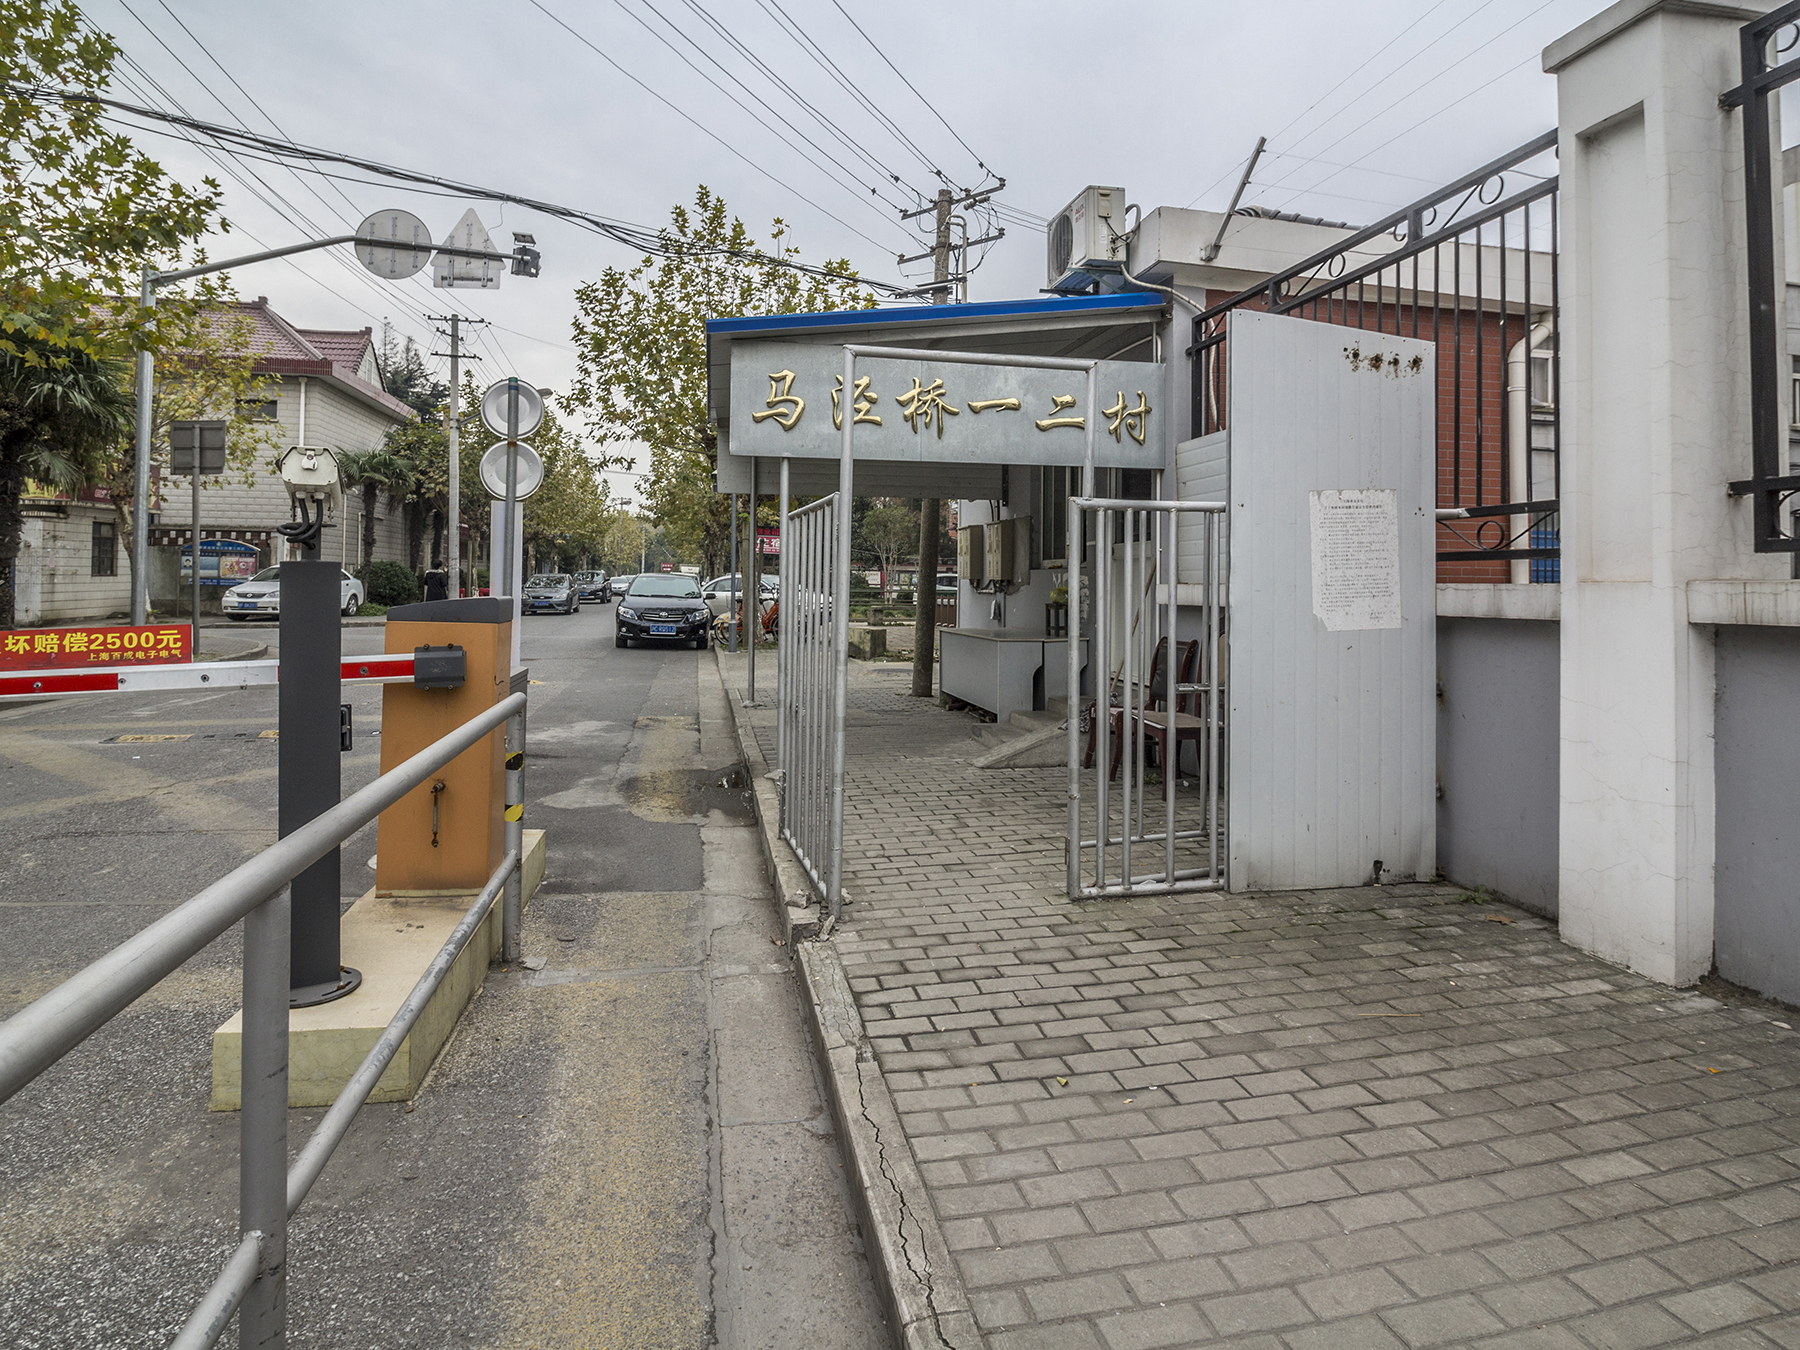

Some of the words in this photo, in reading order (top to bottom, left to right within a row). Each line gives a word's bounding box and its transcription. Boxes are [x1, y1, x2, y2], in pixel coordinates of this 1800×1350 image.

[752, 369, 1153, 446] 马泾桥一二村
[0, 630, 182, 655] 坏赔偿2500元
[86, 649, 182, 662] 上海百成电子电气
